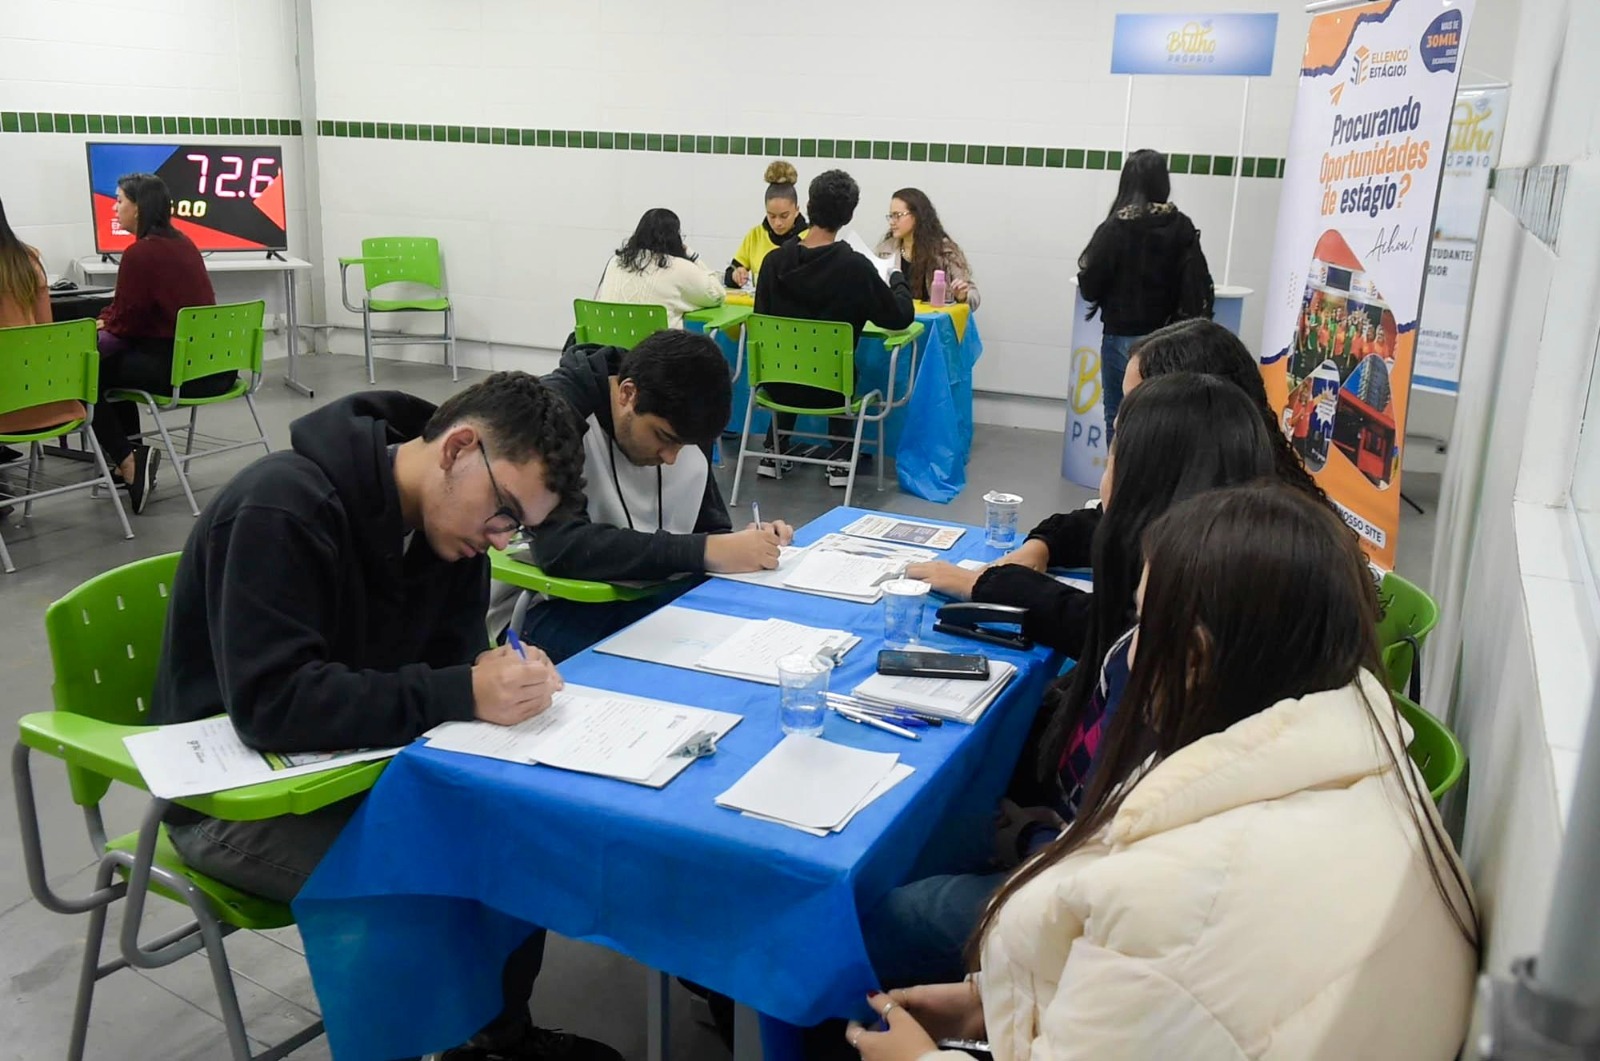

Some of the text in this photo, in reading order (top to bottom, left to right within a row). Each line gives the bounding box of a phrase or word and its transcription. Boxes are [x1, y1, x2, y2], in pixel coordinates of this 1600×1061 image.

[1371, 49, 1408, 64] ELLENCO
[1426, 32, 1458, 48] 30MIL
[1369, 64, 1408, 78] ESTÁGIOS
[1331, 95, 1421, 147] Procurando
[186, 153, 276, 199] 72.6
[1319, 136, 1430, 190] Oportunidades
[1321, 173, 1412, 218] de estágio?
[1365, 224, 1418, 262] Achou!
[1365, 525, 1382, 543] SITE
